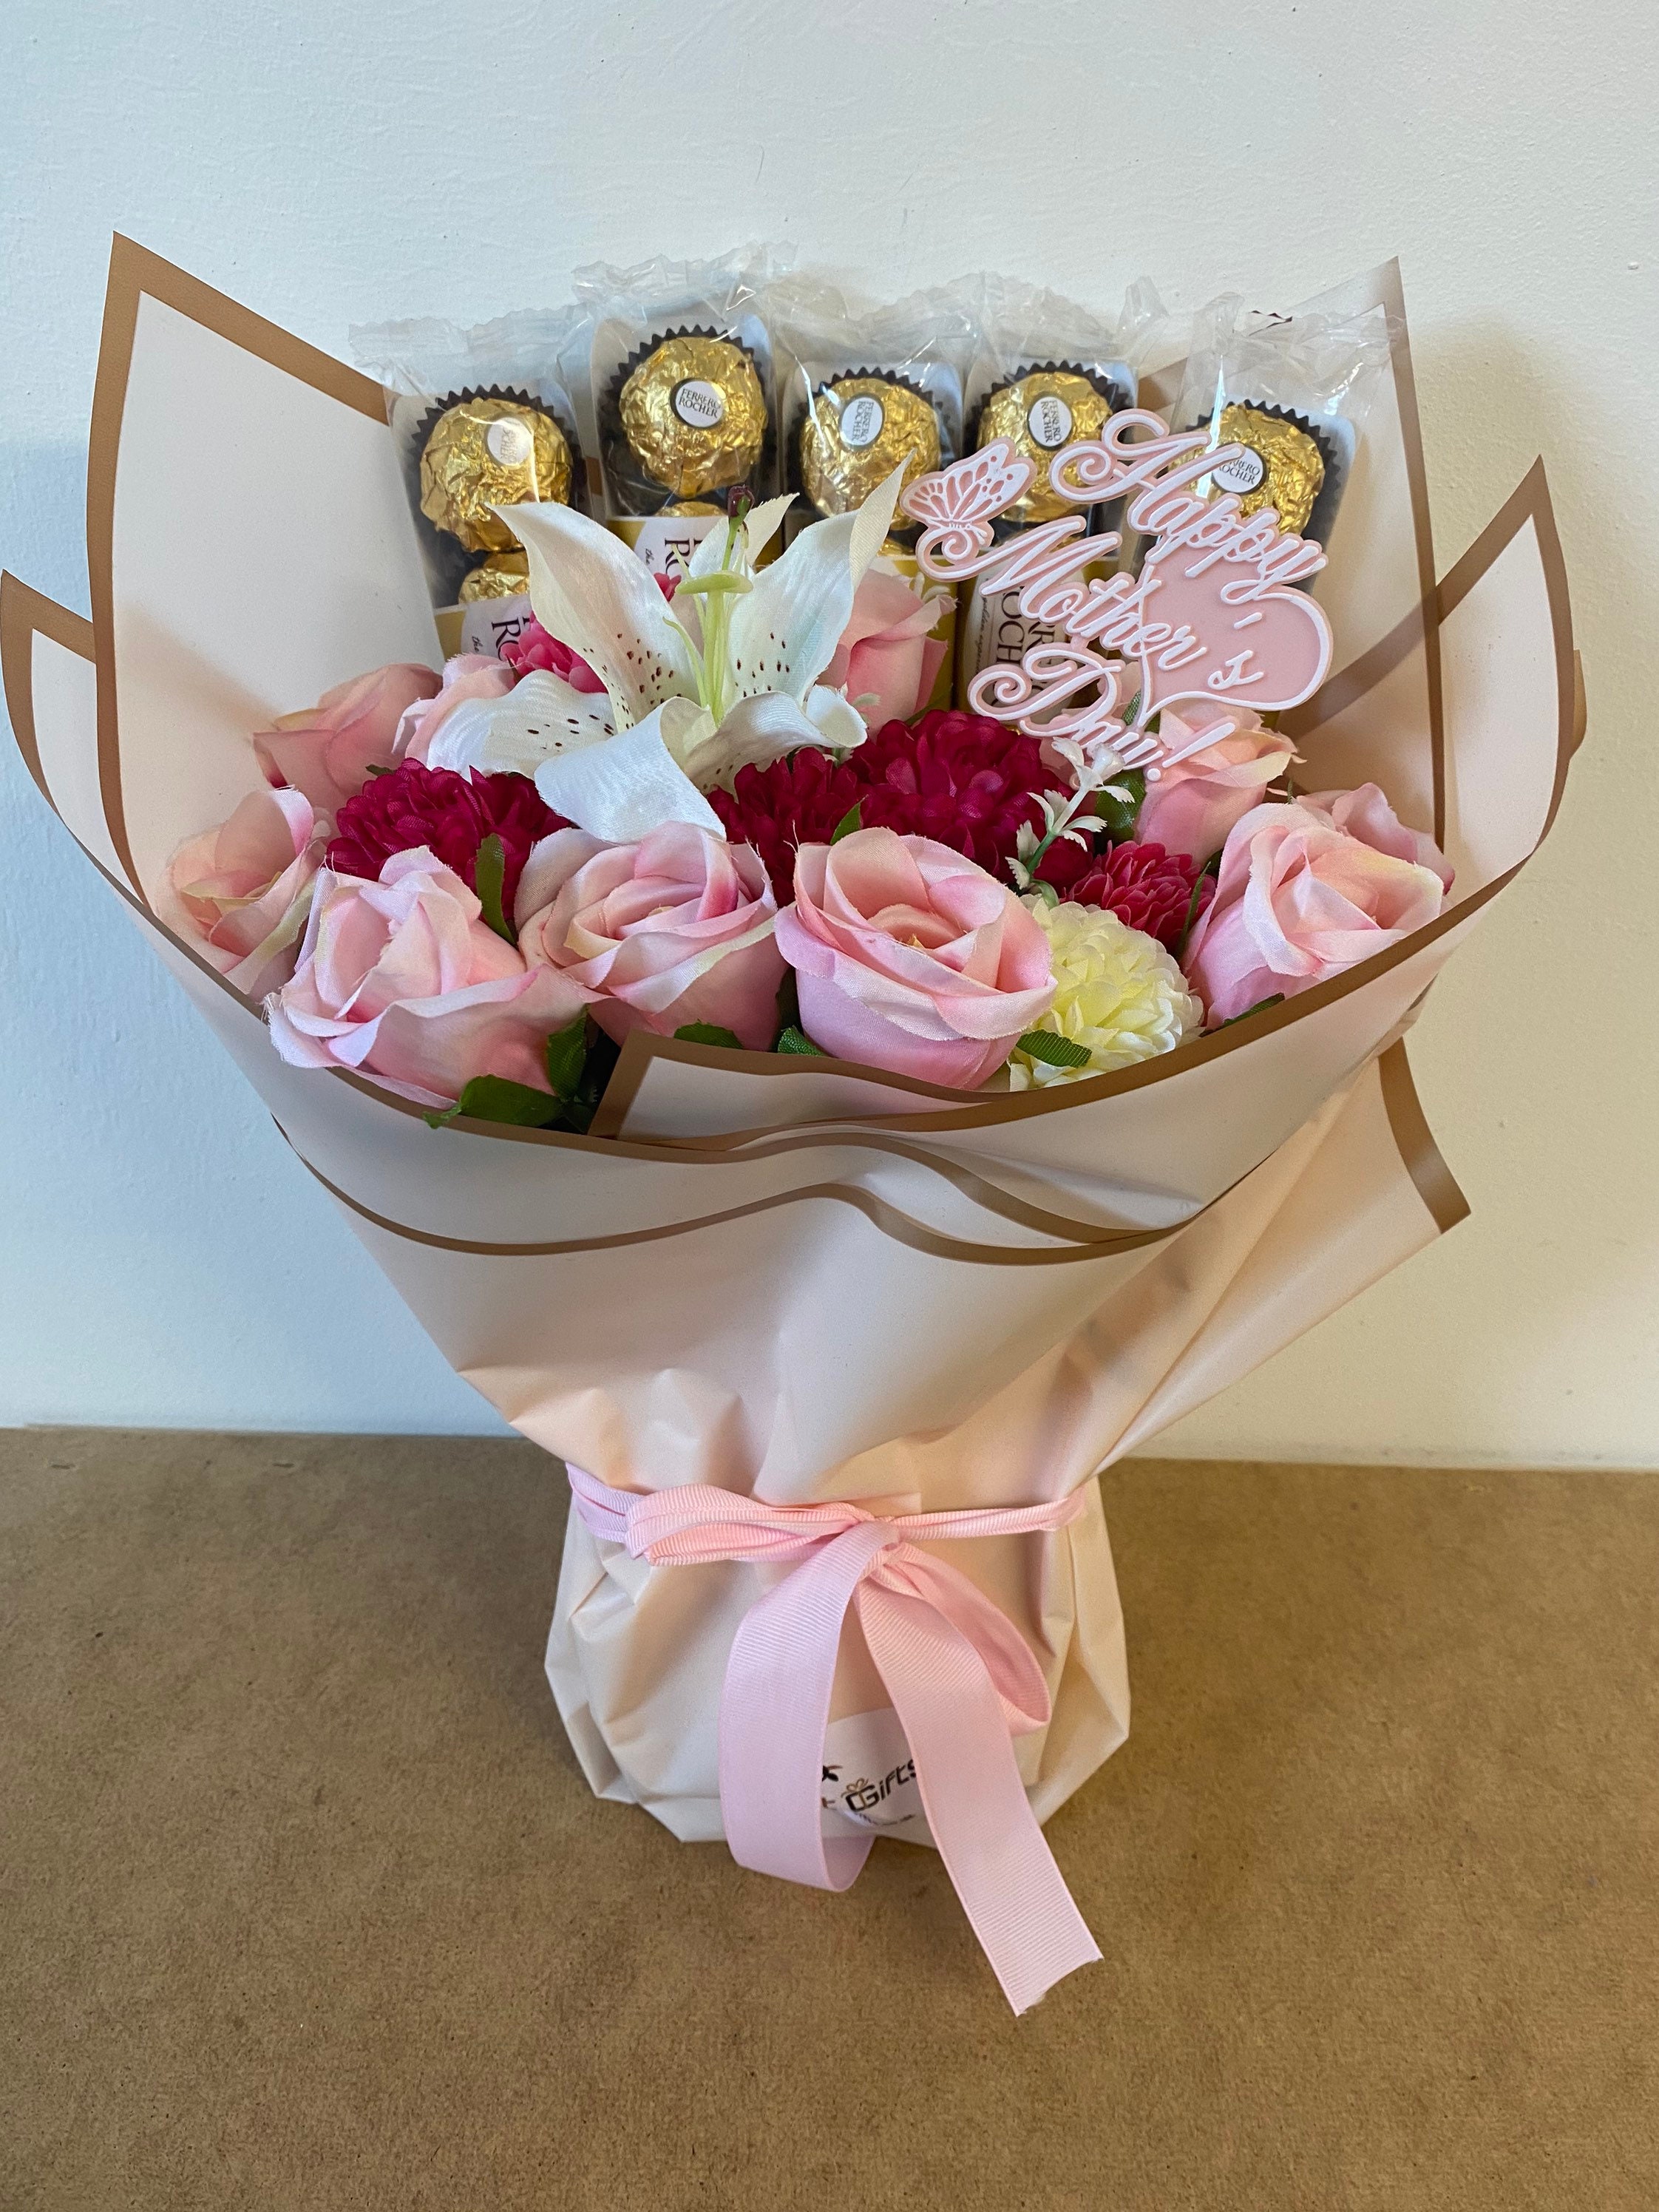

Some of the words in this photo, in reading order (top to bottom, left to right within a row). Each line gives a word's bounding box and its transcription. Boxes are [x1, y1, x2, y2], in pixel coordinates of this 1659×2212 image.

[679, 396, 718, 419] ROCHER
[682, 388, 721, 410] FERRERO
[852, 401, 866, 441] ROCHER
[859, 401, 874, 443] FERRERO
[1040, 401, 1053, 442] ROCHER
[1050, 400, 1062, 441] FERRERO
[1050, 411, 1328, 605] Happy
